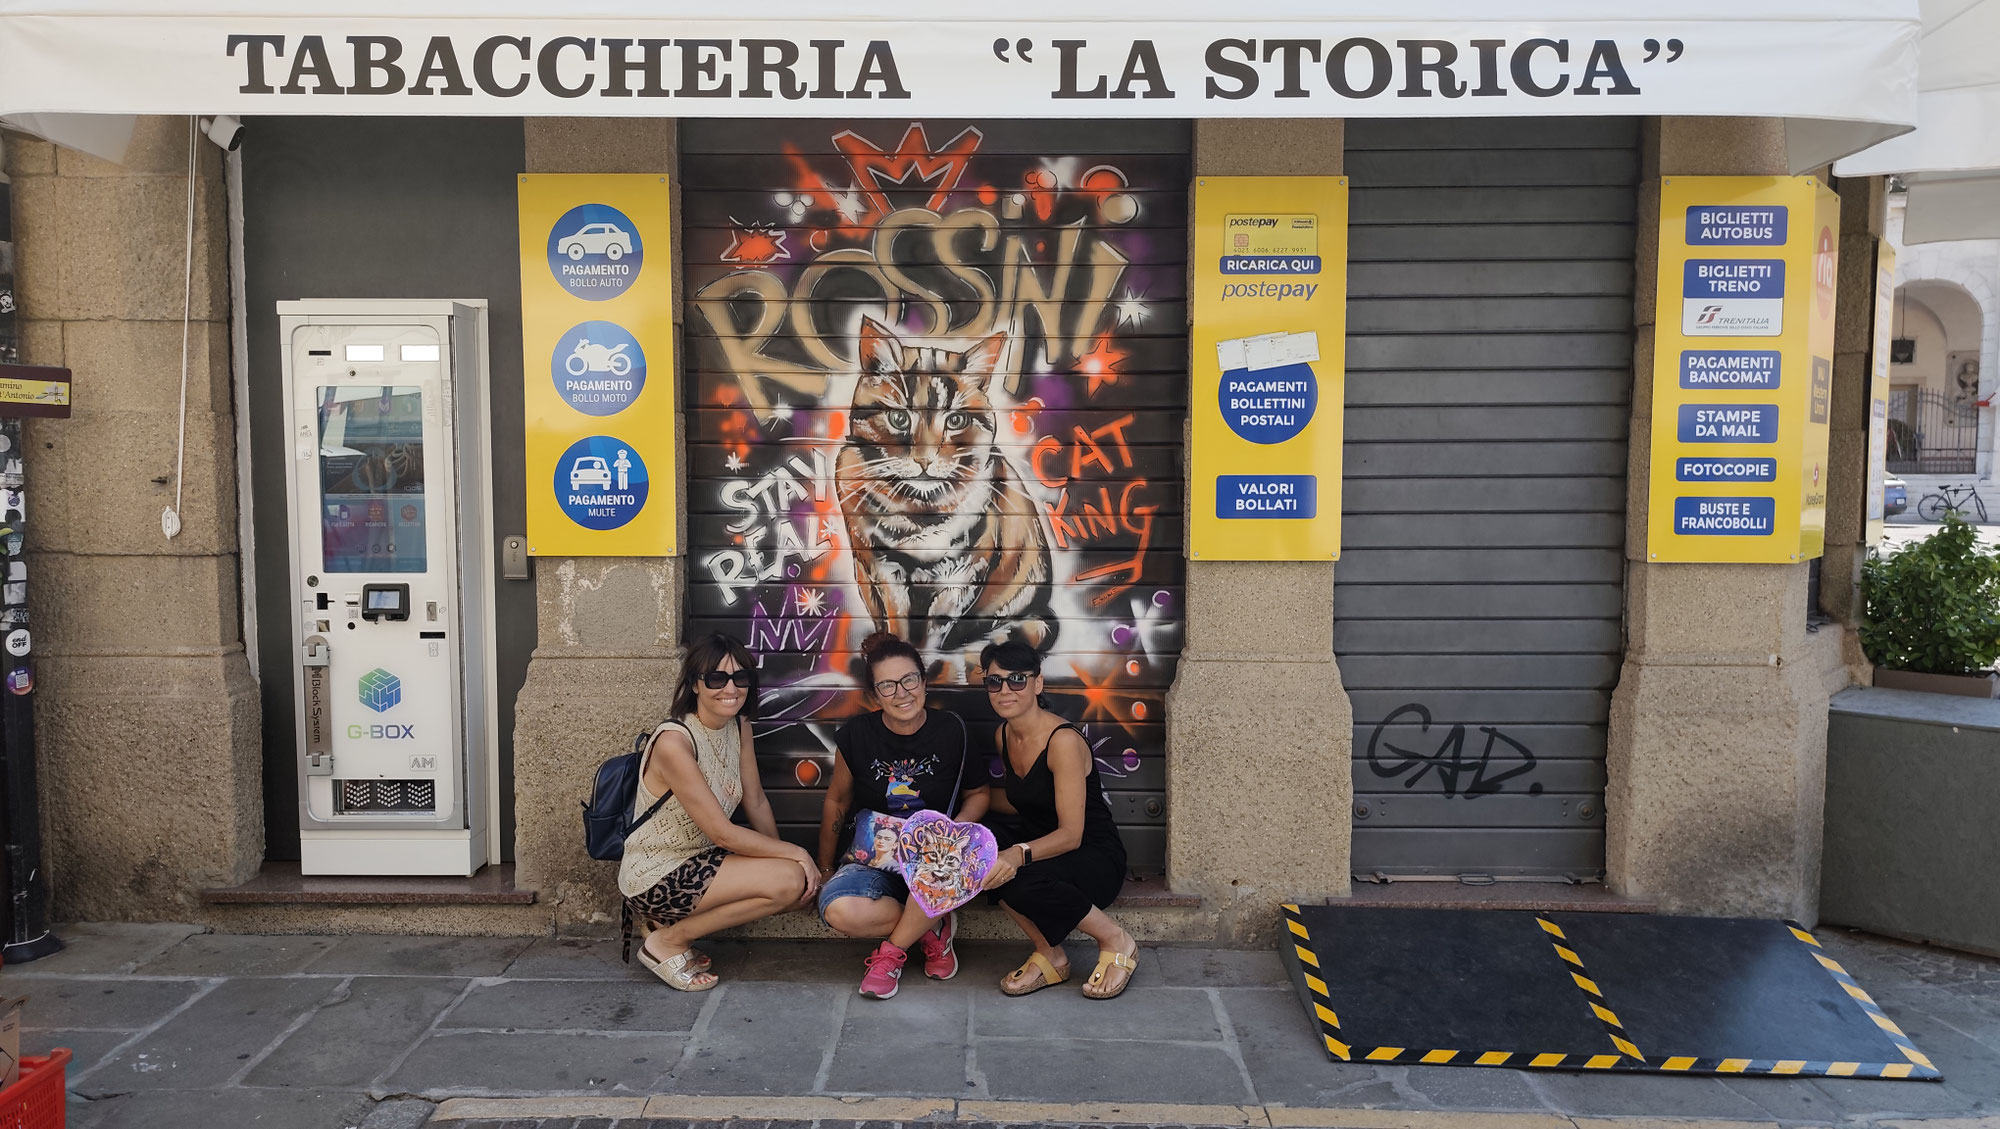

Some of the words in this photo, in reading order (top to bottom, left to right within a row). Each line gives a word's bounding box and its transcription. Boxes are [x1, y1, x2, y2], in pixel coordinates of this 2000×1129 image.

[227, 34, 911, 100] TABACCHERIA
[1229, 218, 1279, 229] postepay
[1700, 212, 1774, 225] BIGLIETTI
[1700, 227, 1773, 239] AUTOBUS
[562, 264, 630, 275] PAGAMENTO
[1226, 259, 1289, 271] RICARICA
[1291, 259, 1315, 272] QUI
[1698, 265, 1771, 278] BIGLIETTI
[570, 278, 598, 287] BOLLO
[600, 278, 623, 287] AUTO
[1708, 280, 1761, 292] TRENO
[1221, 281, 1319, 302] postepay
[1719, 317, 1769, 325] TRENITALIA
[1688, 356, 1774, 369] PAGAMENTI
[1689, 371, 1771, 383] BANCOMAT
[566, 380, 633, 391] PAGAMENTO
[1229, 381, 1308, 393] PAGAMENTI
[572, 393, 600, 403] BOLLO
[601, 393, 628, 403] MOTO
[1230, 398, 1306, 410] BOLLETTINI
[1240, 415, 1295, 426] POSTALI
[1696, 410, 1761, 423] STAMPE
[1695, 425, 1718, 437] DA
[1722, 425, 1761, 437] MAIL
[1032, 413, 1135, 488] CAT
[1683, 463, 1770, 476] FOTOCOPIE
[720, 448, 827, 534] STAY
[1238, 483, 1294, 495] VALORI
[568, 494, 635, 506] PAGAMENTO
[1235, 499, 1297, 511] BOLLATI
[588, 508, 616, 517] MULTE
[1699, 503, 1738, 515] BUSTE
[1742, 503, 1751, 515] E
[1681, 517, 1767, 530] FRANCOBOLLI
[707, 516, 834, 606] REAL
[347, 724, 415, 740] G-BOX
